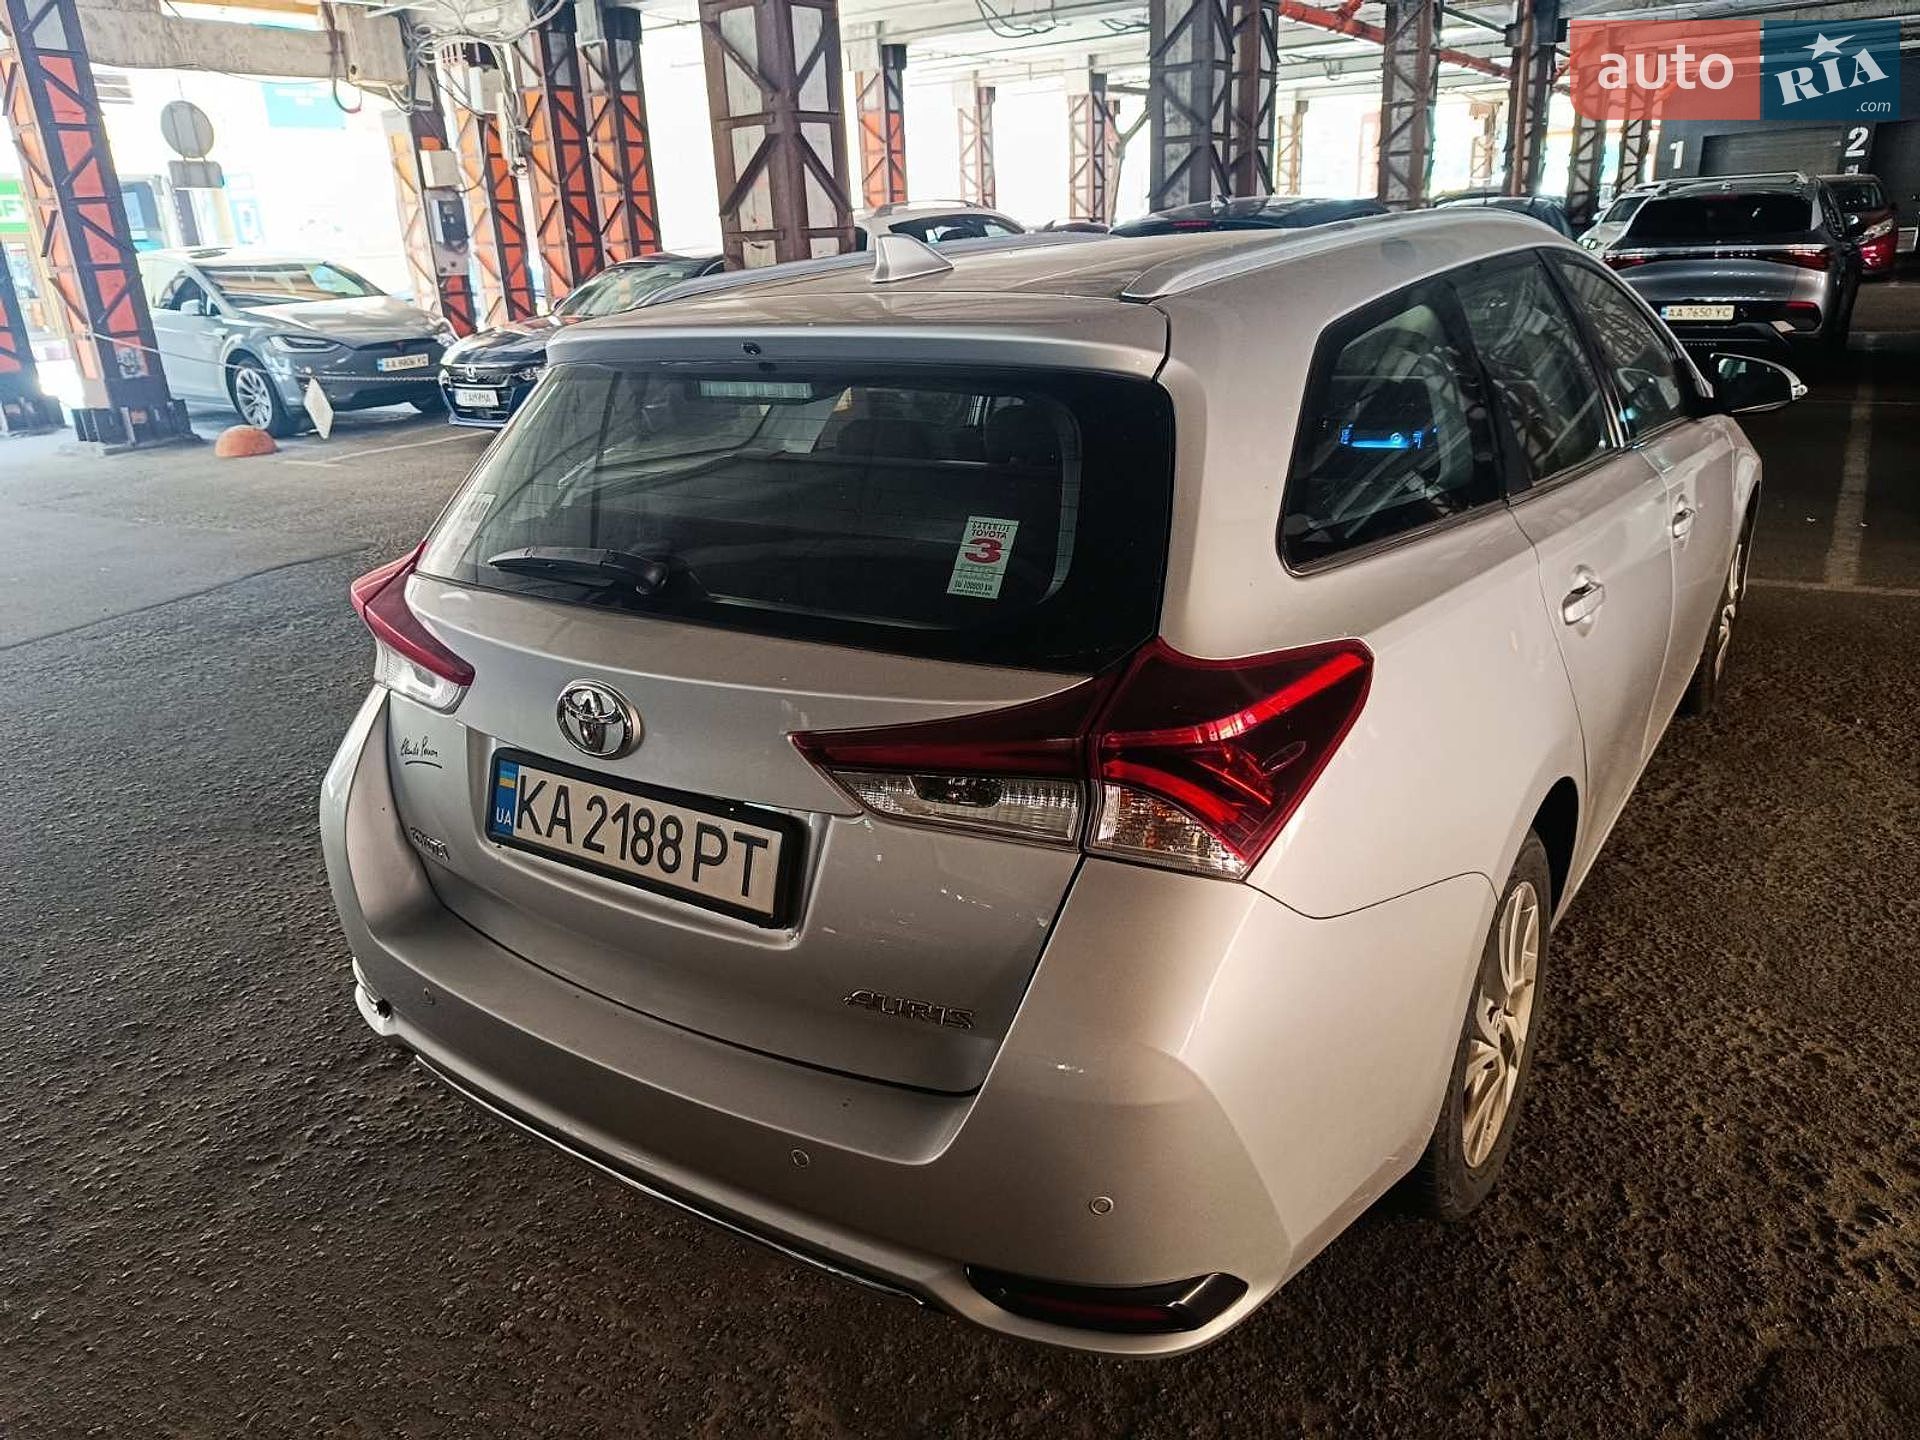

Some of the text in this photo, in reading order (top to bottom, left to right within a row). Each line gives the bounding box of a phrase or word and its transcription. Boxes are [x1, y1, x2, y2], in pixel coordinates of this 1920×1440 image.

[1669, 141, 1684, 169] 1
[1845, 127, 1869, 157] 2
[971, 529, 1007, 539] TOYOTA
[965, 538, 1002, 563] 3
[495, 808, 512, 826] UA
[516, 775, 769, 897] KA 2188 PT
[843, 988, 974, 1030] AURIS
